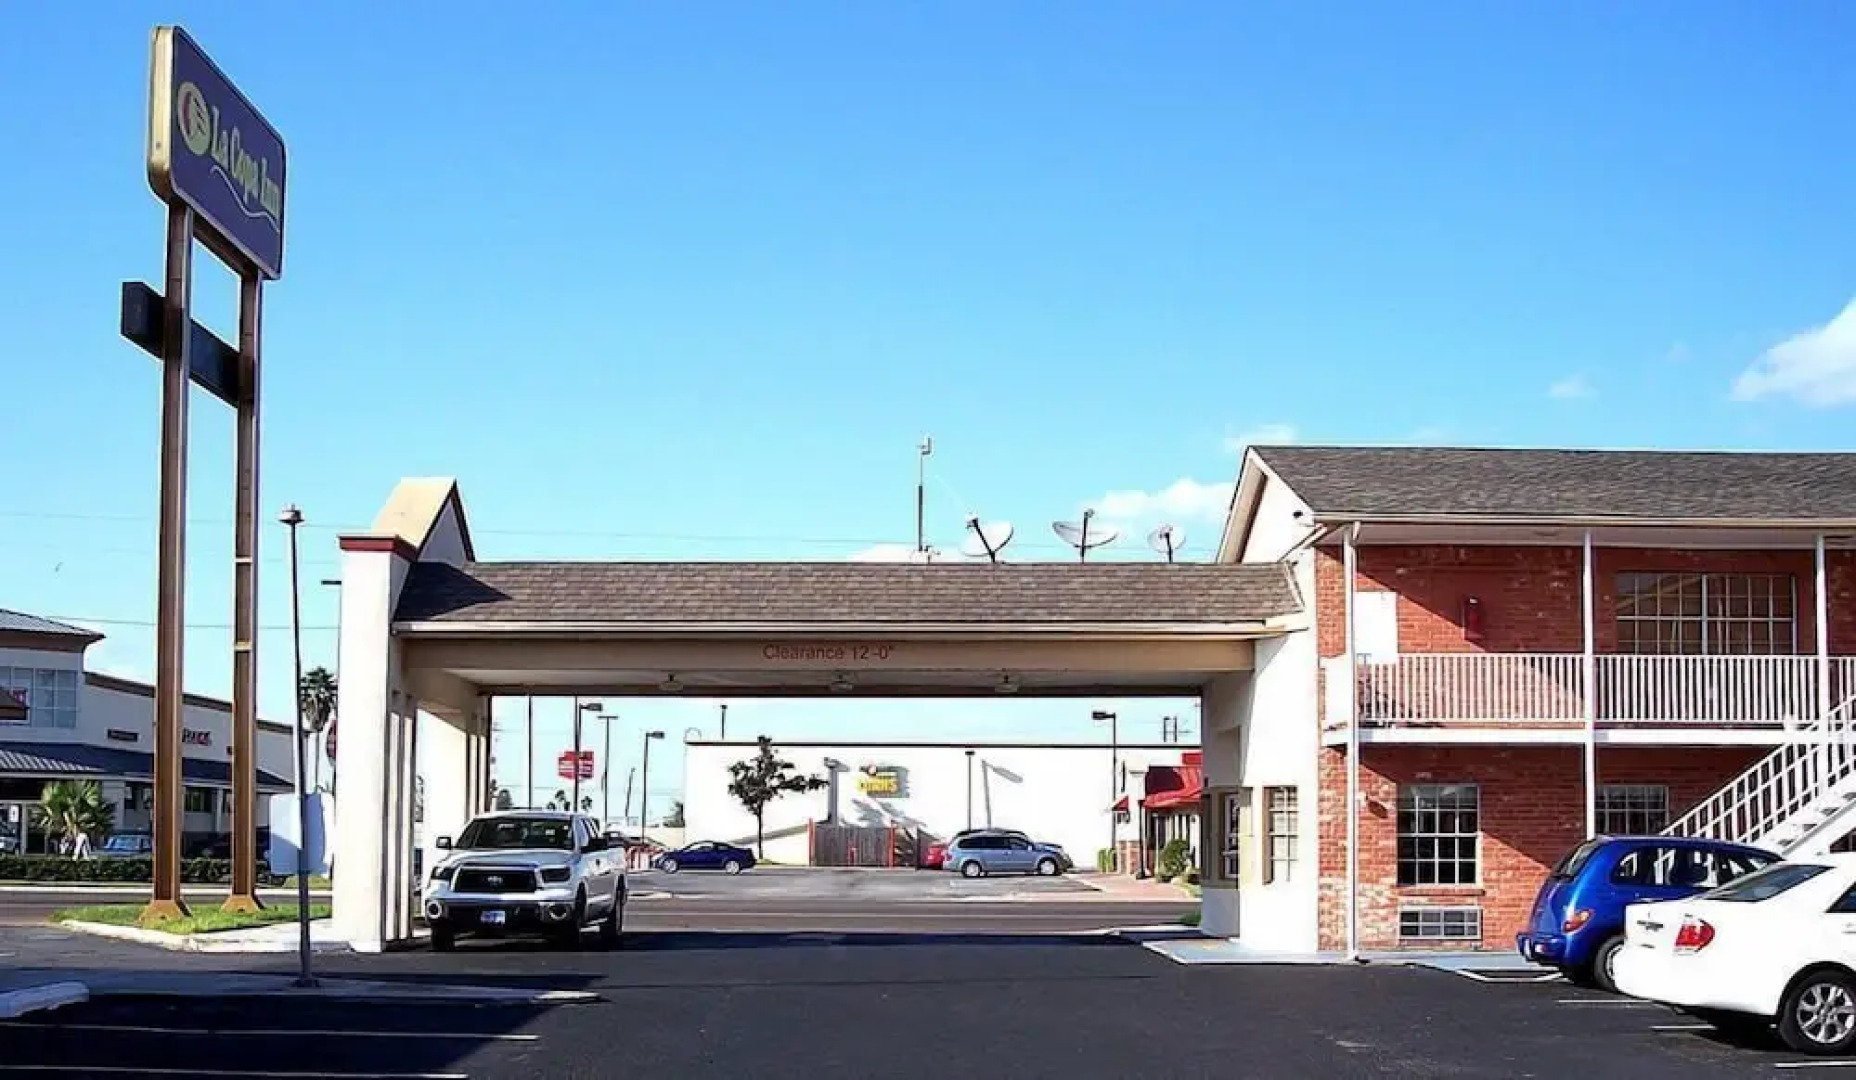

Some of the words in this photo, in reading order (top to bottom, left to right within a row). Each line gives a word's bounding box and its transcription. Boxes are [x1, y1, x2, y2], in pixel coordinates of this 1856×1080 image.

[211, 105, 228, 170] La
[231, 127, 258, 204] Copa
[260, 157, 281, 222] Inn
[763, 643, 844, 660] Clearance
